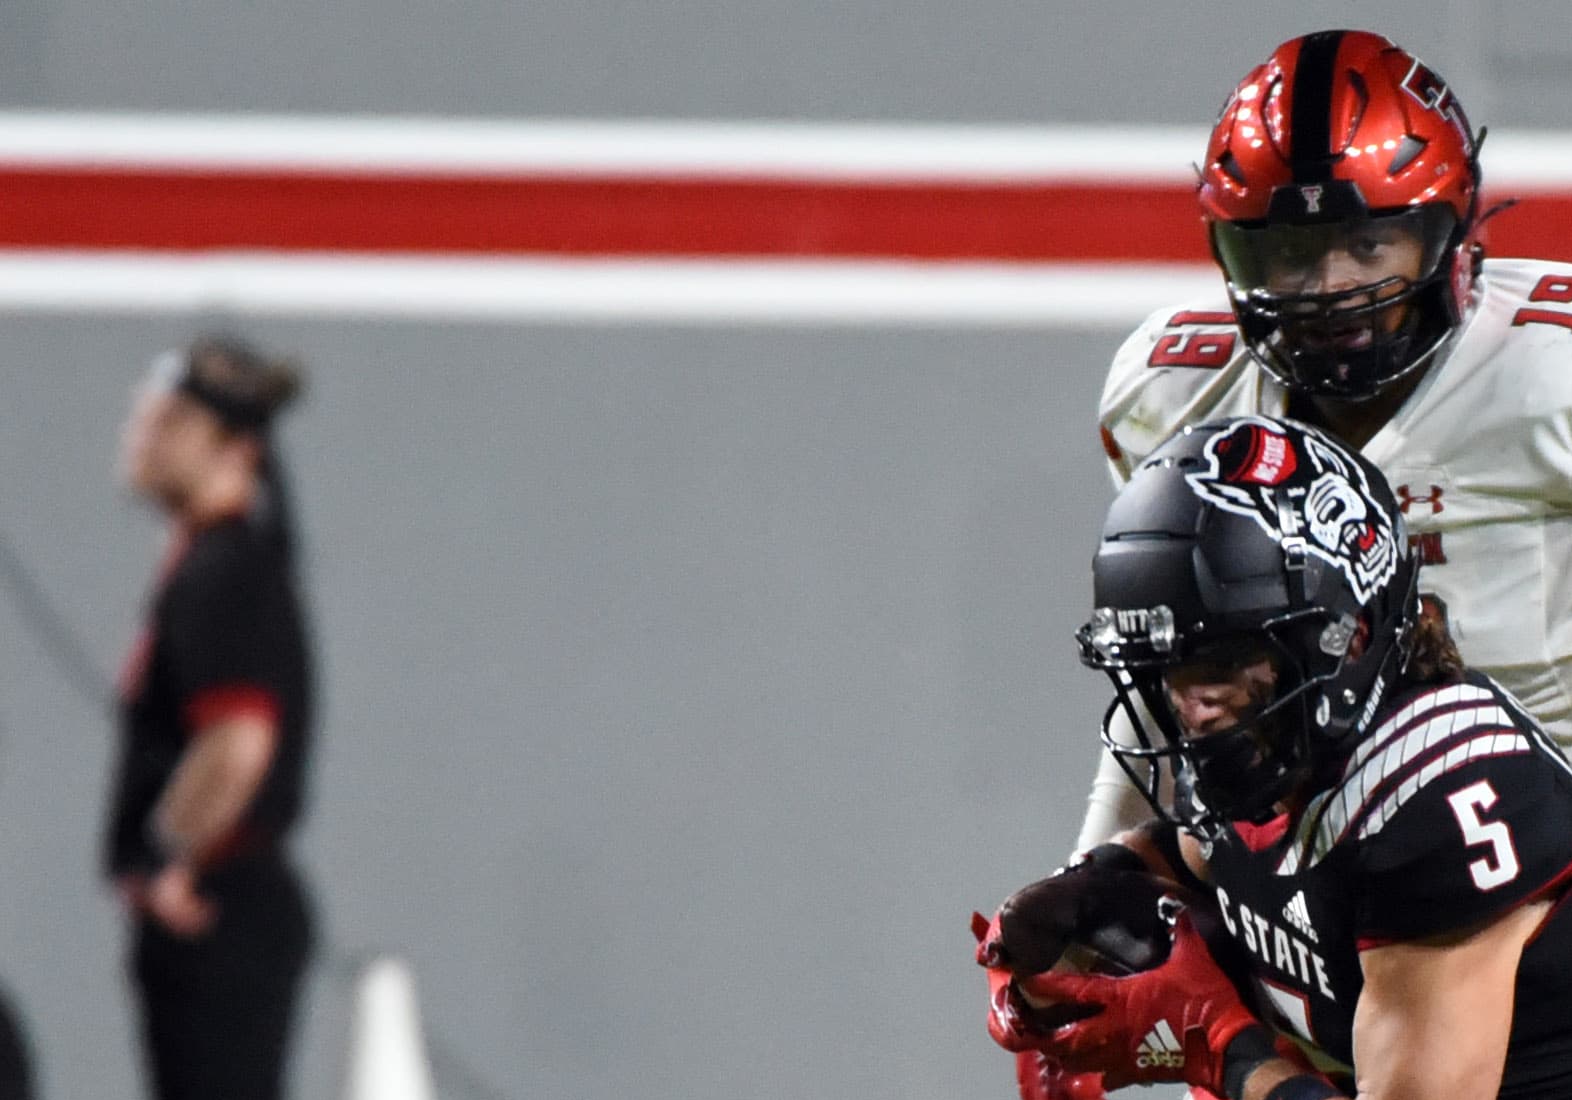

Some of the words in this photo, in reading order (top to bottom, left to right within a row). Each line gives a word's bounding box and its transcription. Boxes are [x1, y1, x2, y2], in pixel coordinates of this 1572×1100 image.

[1147, 310, 1239, 369] 19
[1445, 779, 1522, 892] 5
[1239, 903, 1337, 1001] STATE
